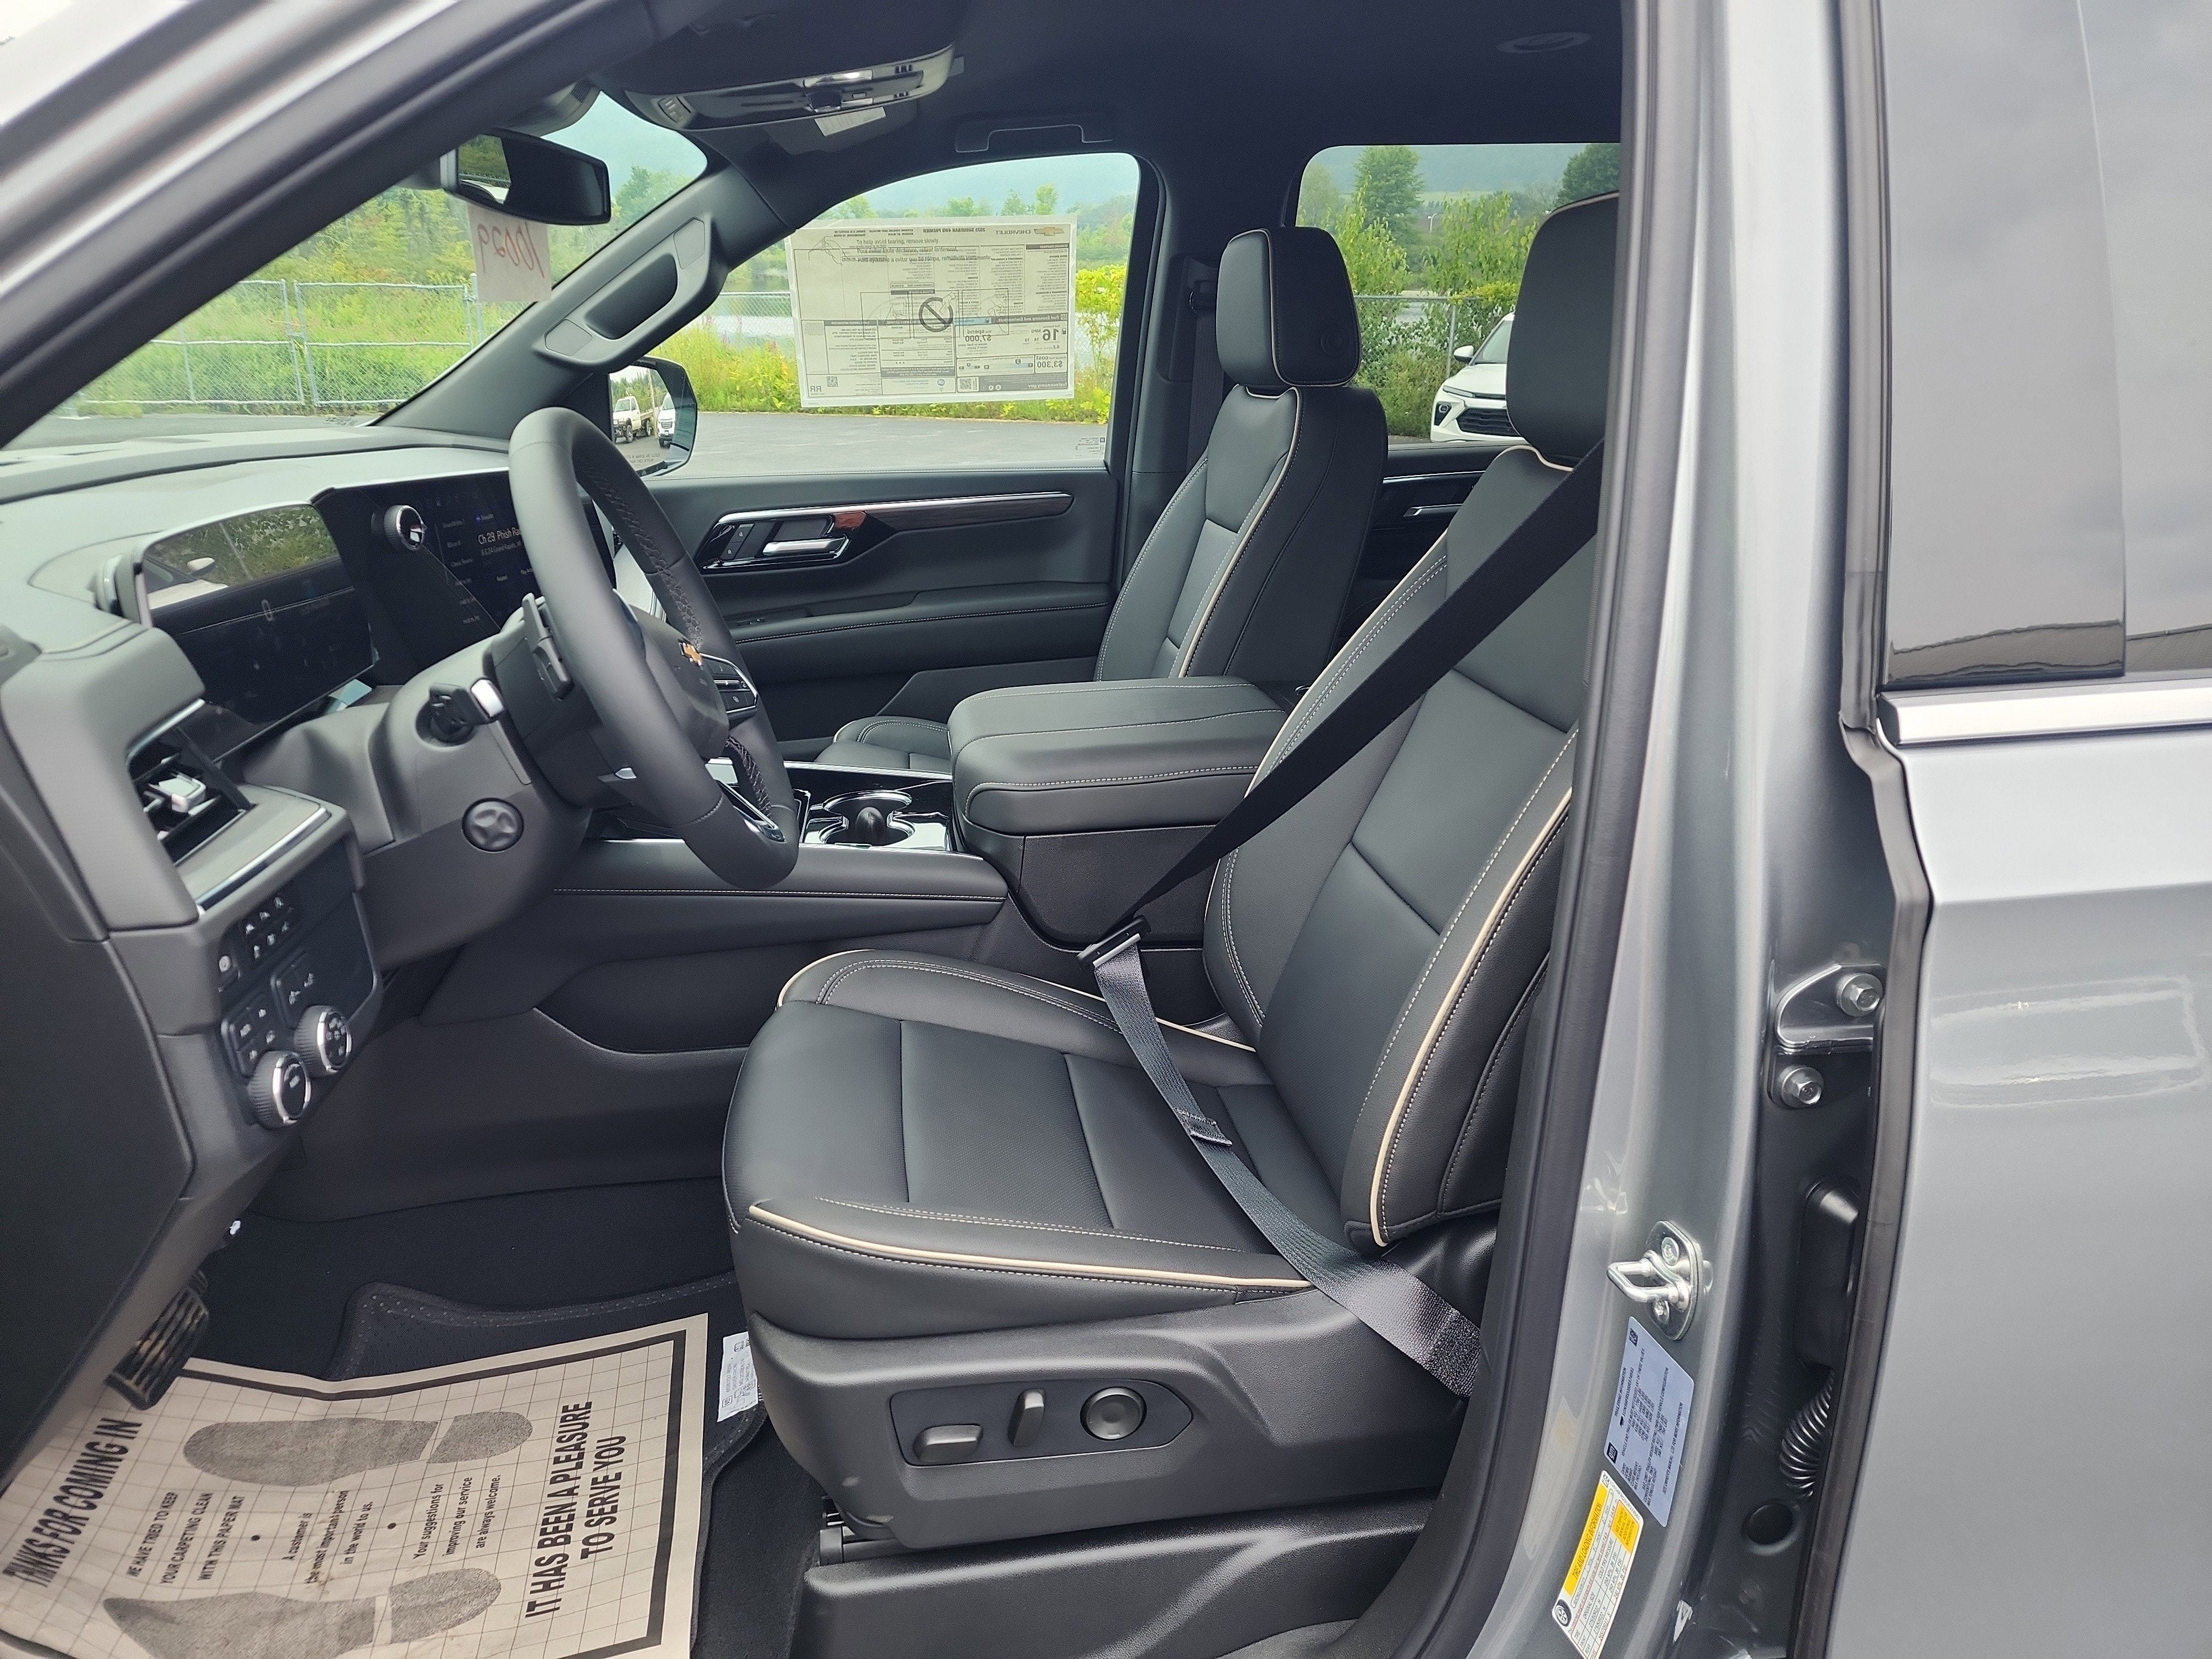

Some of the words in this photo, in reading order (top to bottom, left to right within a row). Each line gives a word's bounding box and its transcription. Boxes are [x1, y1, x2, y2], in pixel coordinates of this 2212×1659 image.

[478, 534, 488, 545] Ch
[487, 531, 495, 543] 29
[496, 528, 512, 540] Phish
[92, 1417, 143, 1440] IN
[549, 1400, 593, 1486] PLEASURE
[592, 1434, 627, 1473] YOU
[1608, 1444, 1616, 1461] gm
[53, 1441, 129, 1511] COMING
[430, 1483, 445, 1494] for
[458, 1477, 473, 1505] service
[484, 1474, 502, 1511] welcome.
[546, 1484, 581, 1499] A
[584, 1471, 623, 1528] SERVE
[158, 1491, 179, 1510] KEEP
[226, 1495, 246, 1510] MAT
[153, 1510, 169, 1521] TO
[215, 1510, 240, 1538] PAPER
[354, 1512, 369, 1522] to
[420, 1494, 441, 1541] suggestions
[455, 1507, 467, 1519] our
[477, 1511, 495, 1536] always
[1587, 1500, 1604, 1536] INFORMATION
[32, 1508, 90, 1545] FOR
[141, 1522, 164, 1545] TRIED
[311, 1549, 328, 1570] most
[332, 1490, 350, 1515] person
[351, 1522, 367, 1543] world
[536, 1501, 578, 1550] BEEN
[159, 1562, 181, 1584] YOUR
[170, 1516, 202, 1563] CARPETING
[190, 1493, 215, 1516] CLEAN
[206, 1538, 227, 1558] THIS
[287, 1520, 310, 1555] customer
[343, 1542, 360, 1555] the
[442, 1520, 466, 1557] improving
[475, 1536, 487, 1549] are
[579, 1531, 615, 1561] TO
[1579, 1532, 1593, 1559] LOADING
[1603, 1537, 1615, 1560] PRESSURE
[131, 1546, 153, 1567] HAVE
[339, 1556, 355, 1565] in
[413, 1541, 430, 1559] Your
[1575, 1553, 1585, 1569] AND
[196, 1559, 220, 1581] WITH
[529, 1552, 570, 1595] HAS
[1572, 1564, 1580, 1580] TIRE
[524, 1597, 562, 1619] IT
[1582, 1599, 1592, 1620] ORIGINAL
